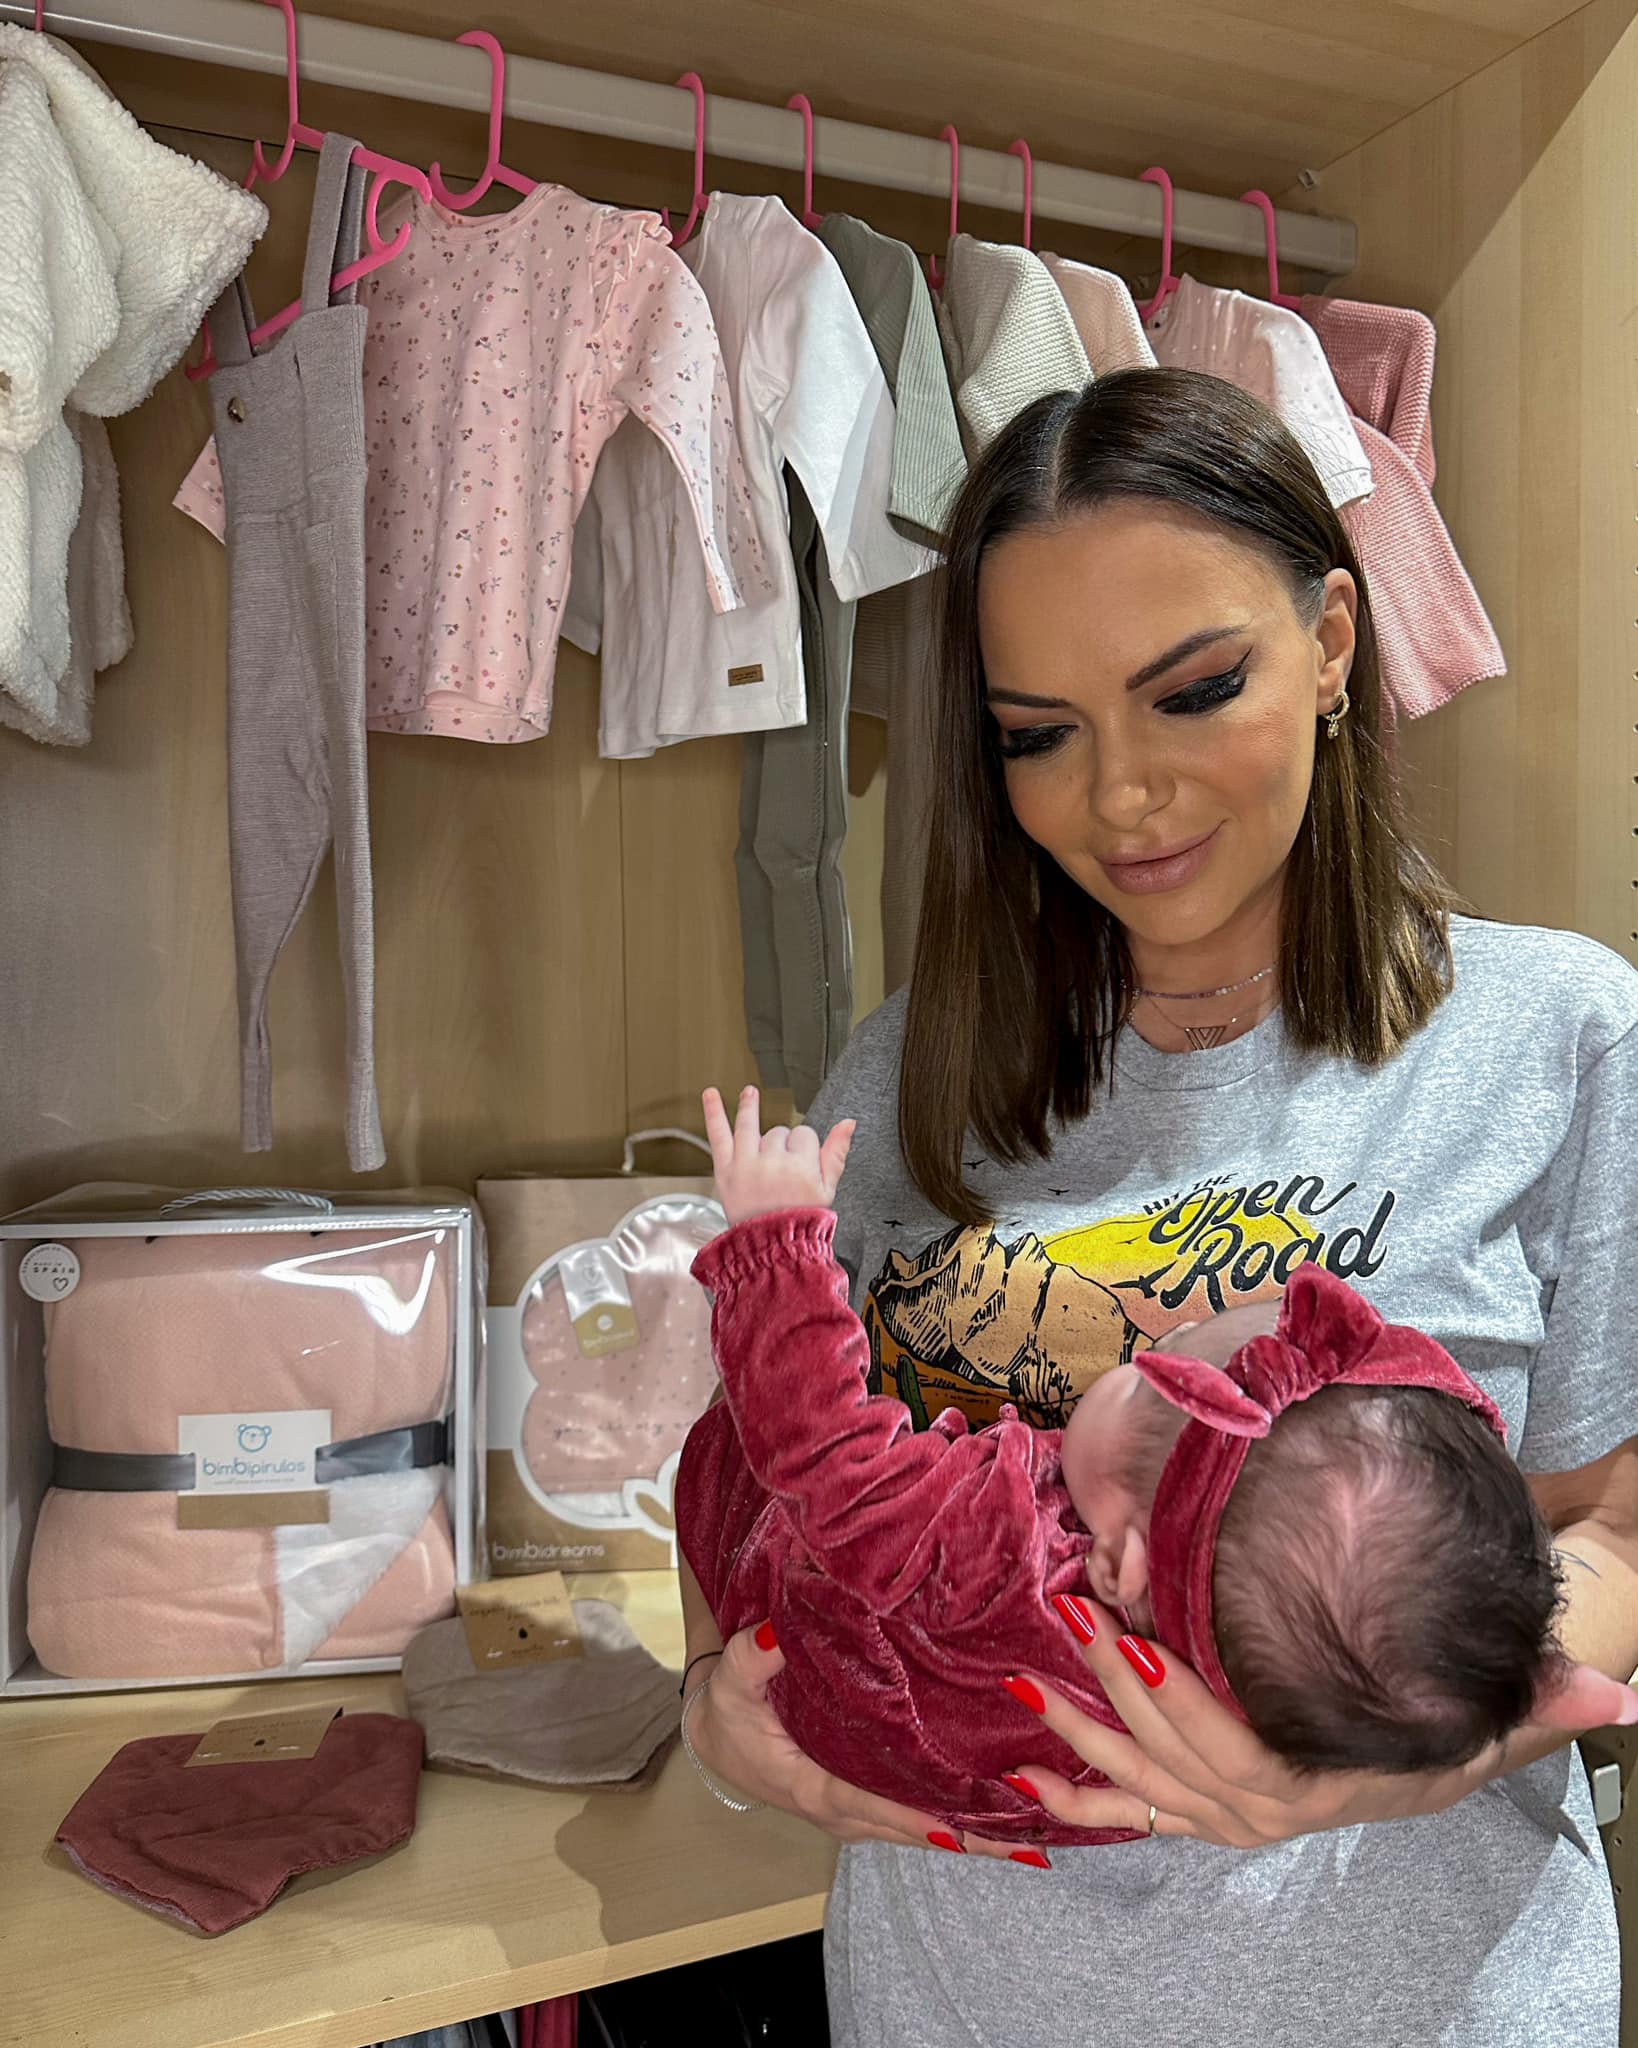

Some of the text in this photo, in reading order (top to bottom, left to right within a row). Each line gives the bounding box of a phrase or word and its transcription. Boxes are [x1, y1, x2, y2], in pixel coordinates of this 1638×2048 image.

[1142, 1172, 1239, 1216] HIT THE
[1148, 1174, 1358, 1256] Open
[33, 1266, 76, 1274] SPAIN
[1159, 1190, 1395, 1314] Road
[202, 1456, 305, 1477] bimbipirulos
